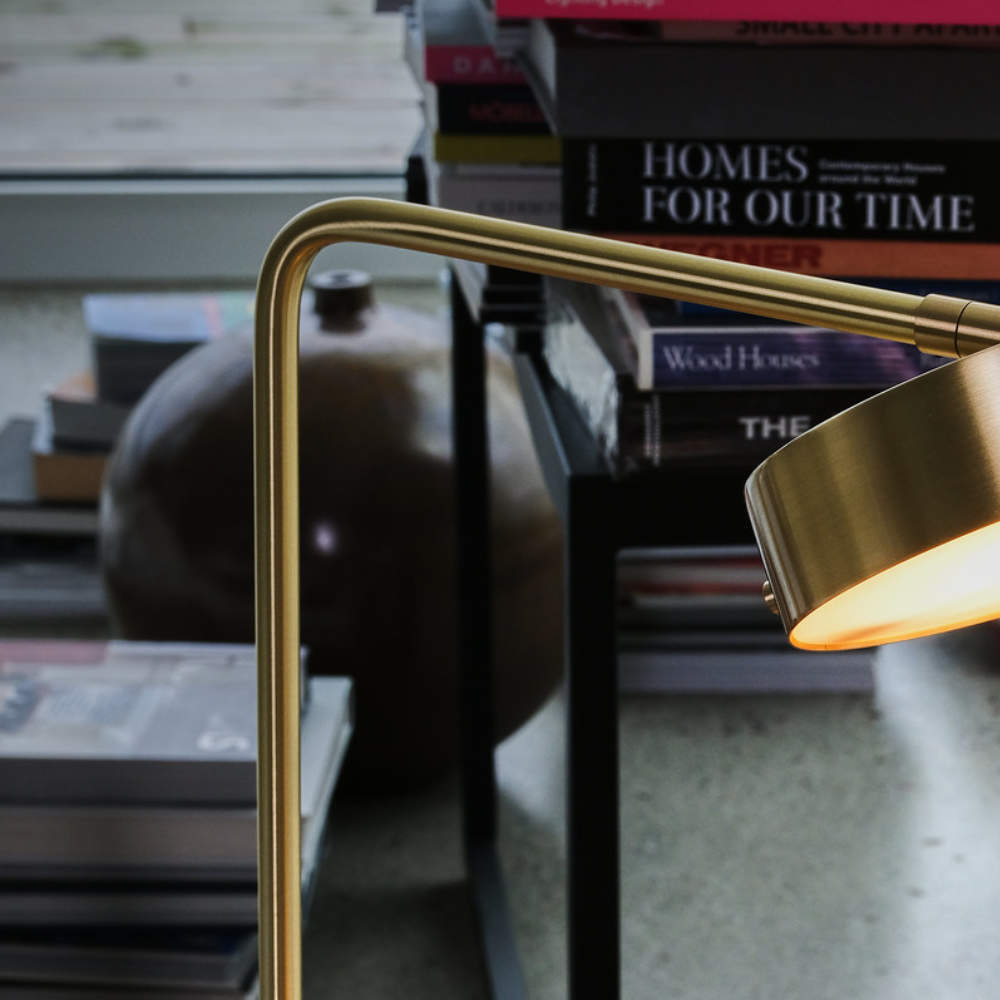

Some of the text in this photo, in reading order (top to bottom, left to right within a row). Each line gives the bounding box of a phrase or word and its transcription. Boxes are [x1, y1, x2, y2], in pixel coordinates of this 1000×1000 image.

[641, 141, 809, 183] HOMES
[641, 185, 976, 233] FOR OUR TIME
[663, 344, 820, 371] Wood Houses
